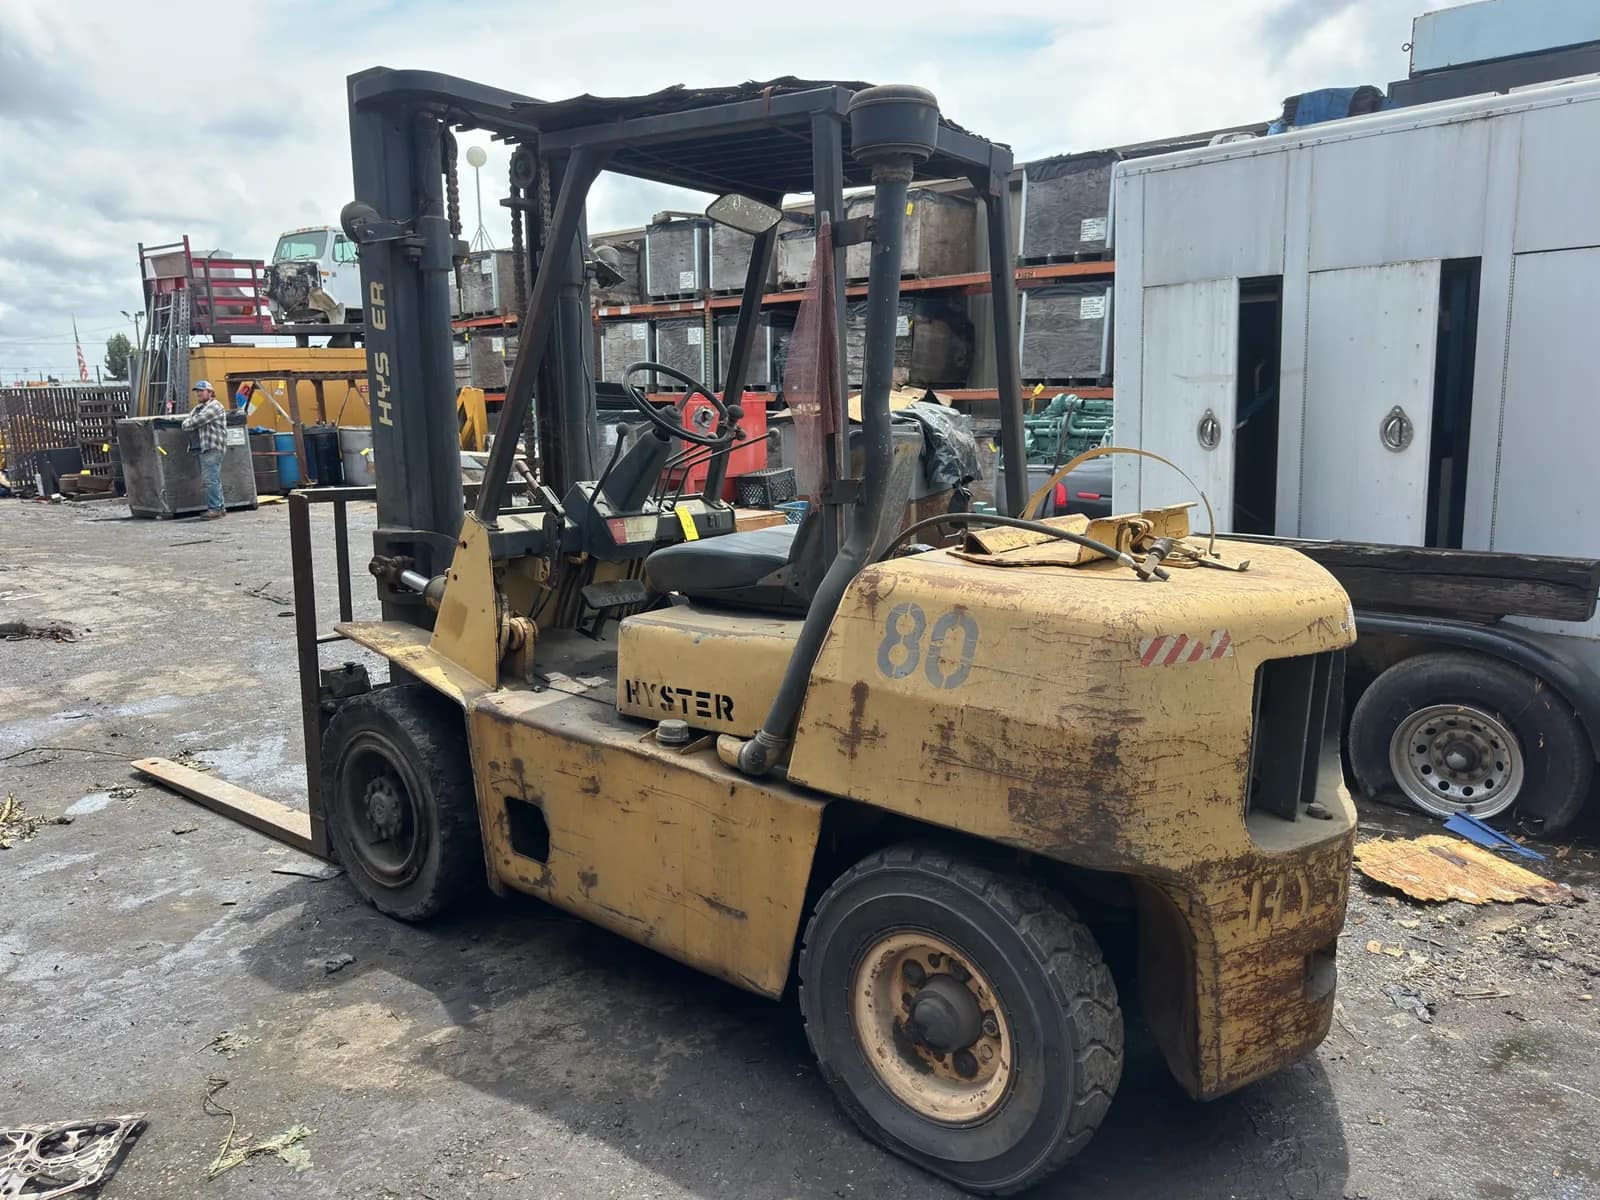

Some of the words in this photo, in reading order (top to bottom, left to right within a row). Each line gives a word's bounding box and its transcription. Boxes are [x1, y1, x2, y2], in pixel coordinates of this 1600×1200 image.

[370, 281, 393, 427] HYSER
[877, 602, 979, 689] 80
[625, 679, 735, 722] HYSTER
